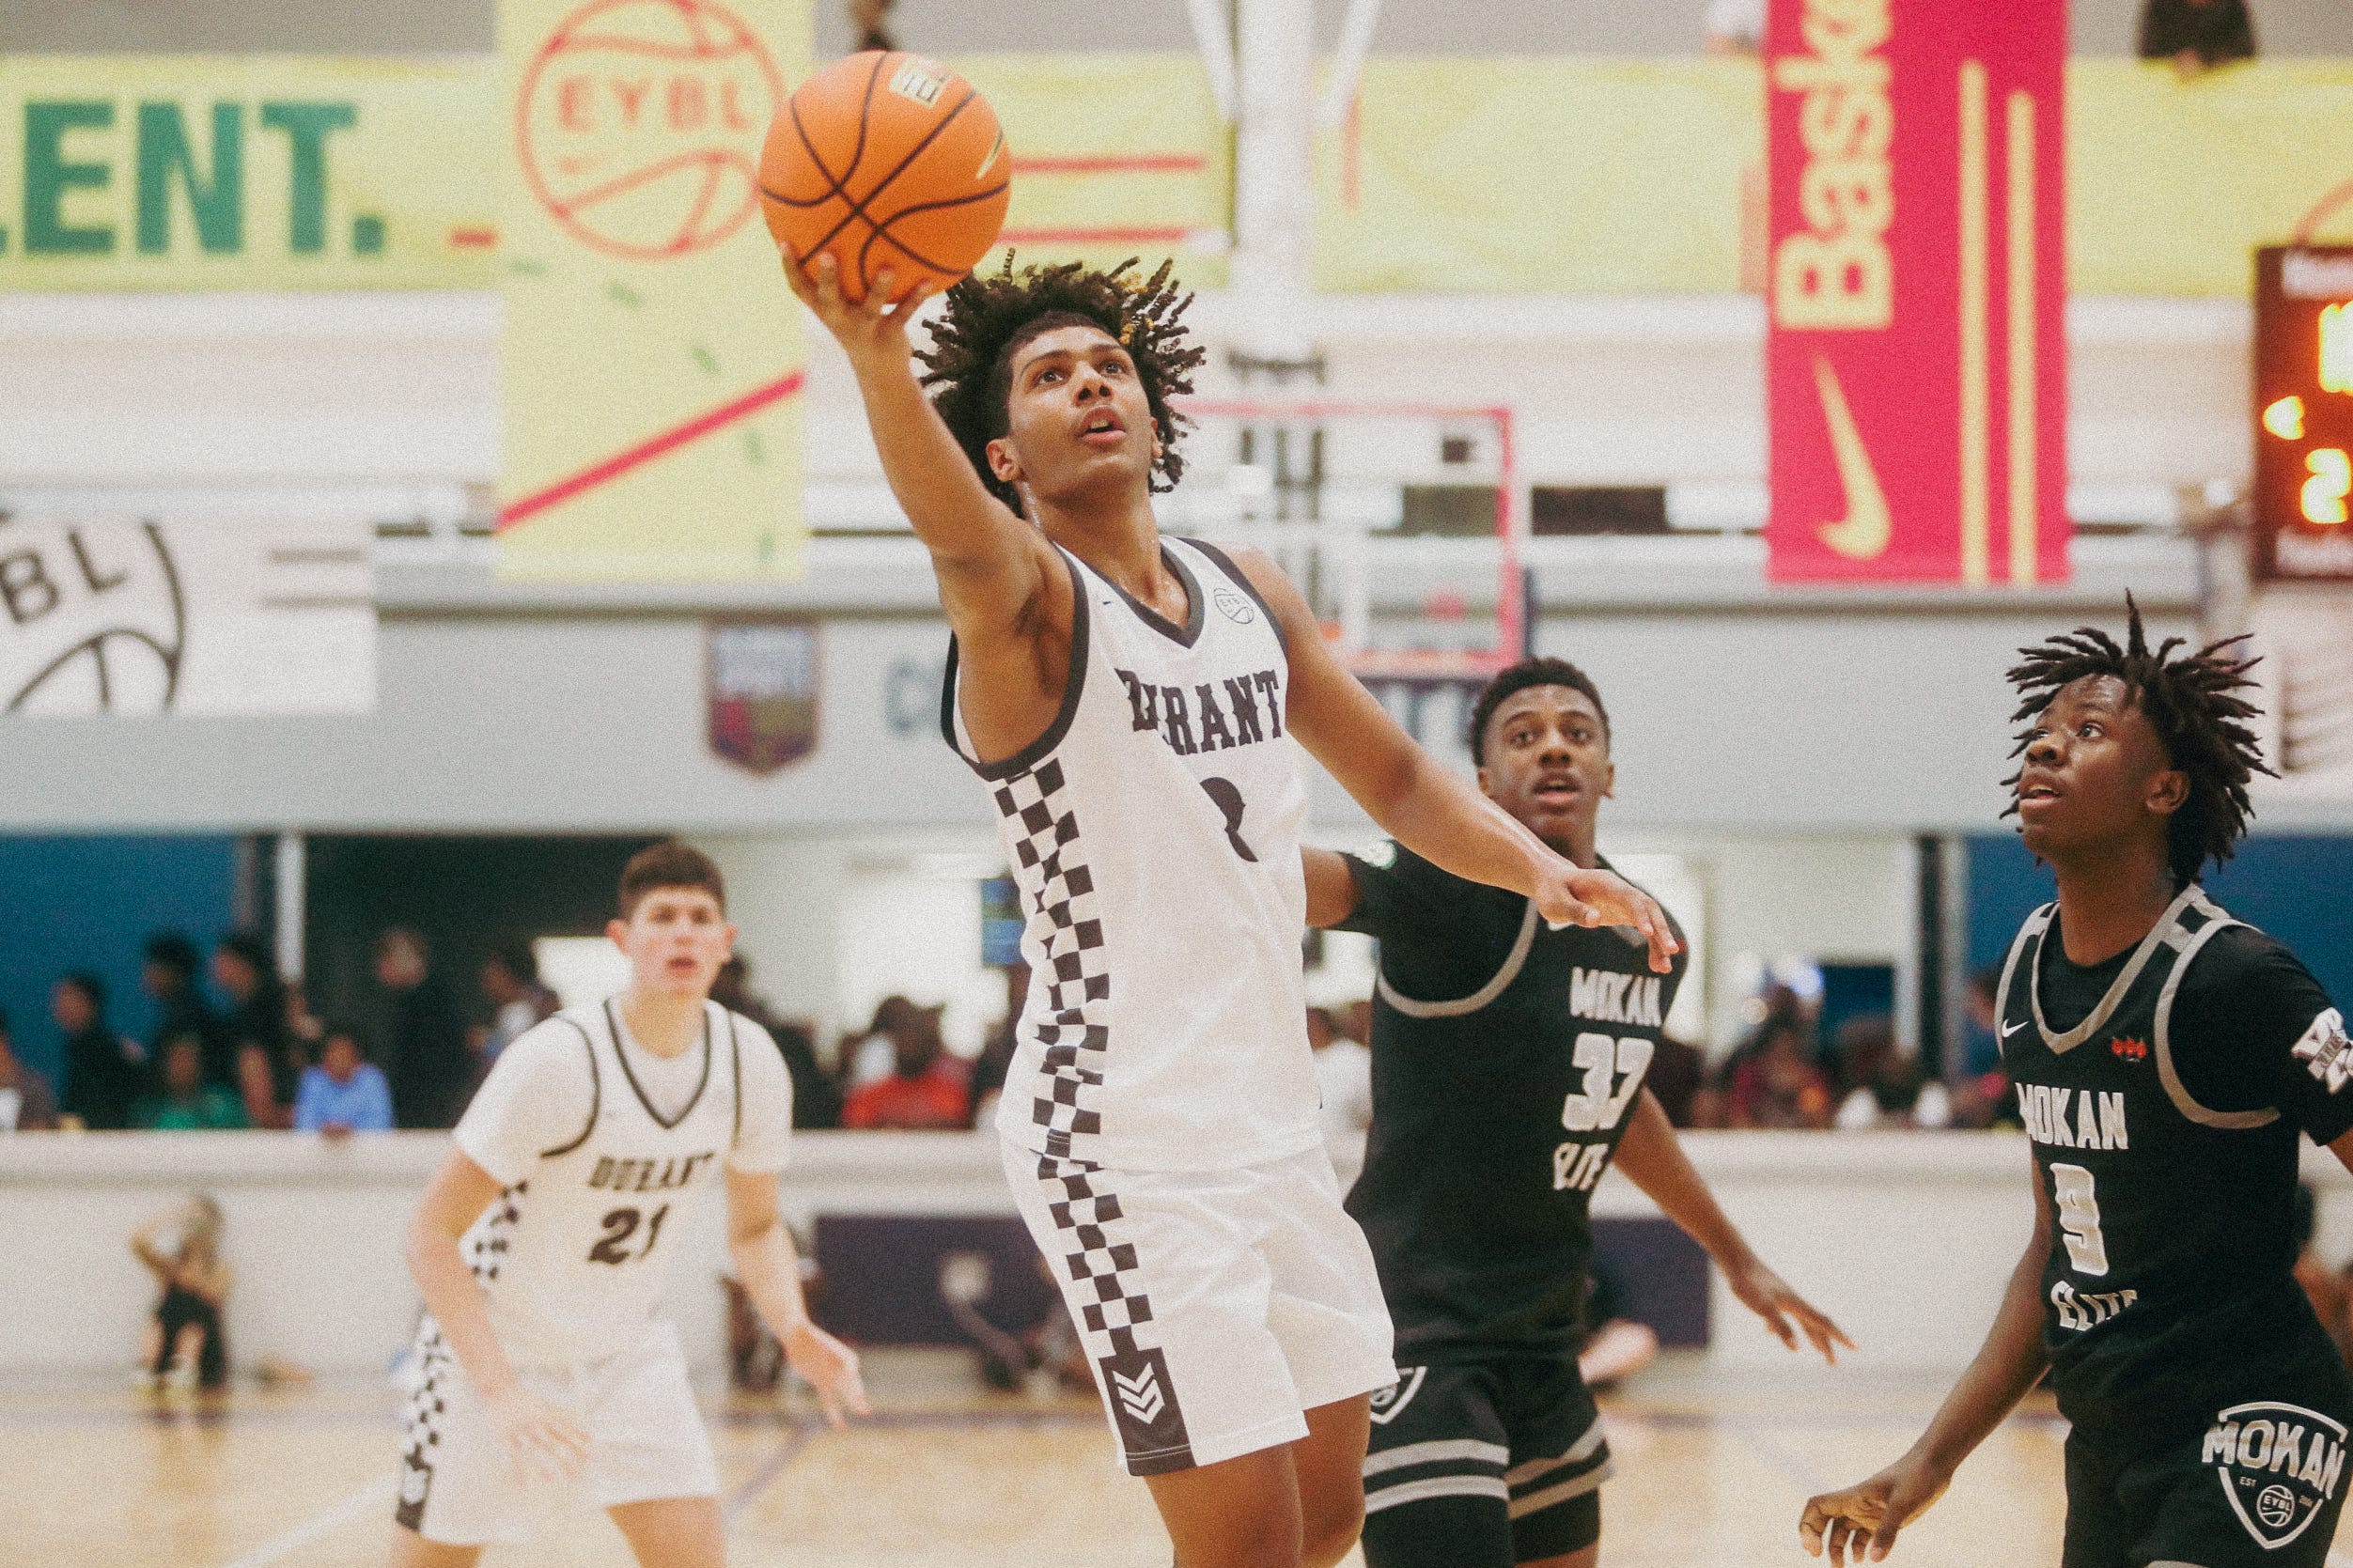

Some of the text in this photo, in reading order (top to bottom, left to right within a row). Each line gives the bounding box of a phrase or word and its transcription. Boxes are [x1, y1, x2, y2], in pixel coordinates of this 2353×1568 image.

[557, 74, 755, 132] EYBL
[0, 101, 386, 255] ENT.
[1569, 966, 1662, 1028] MOKAN
[1561, 1032, 1655, 1132] 37
[2201, 1420, 2347, 1500] MOKAN
